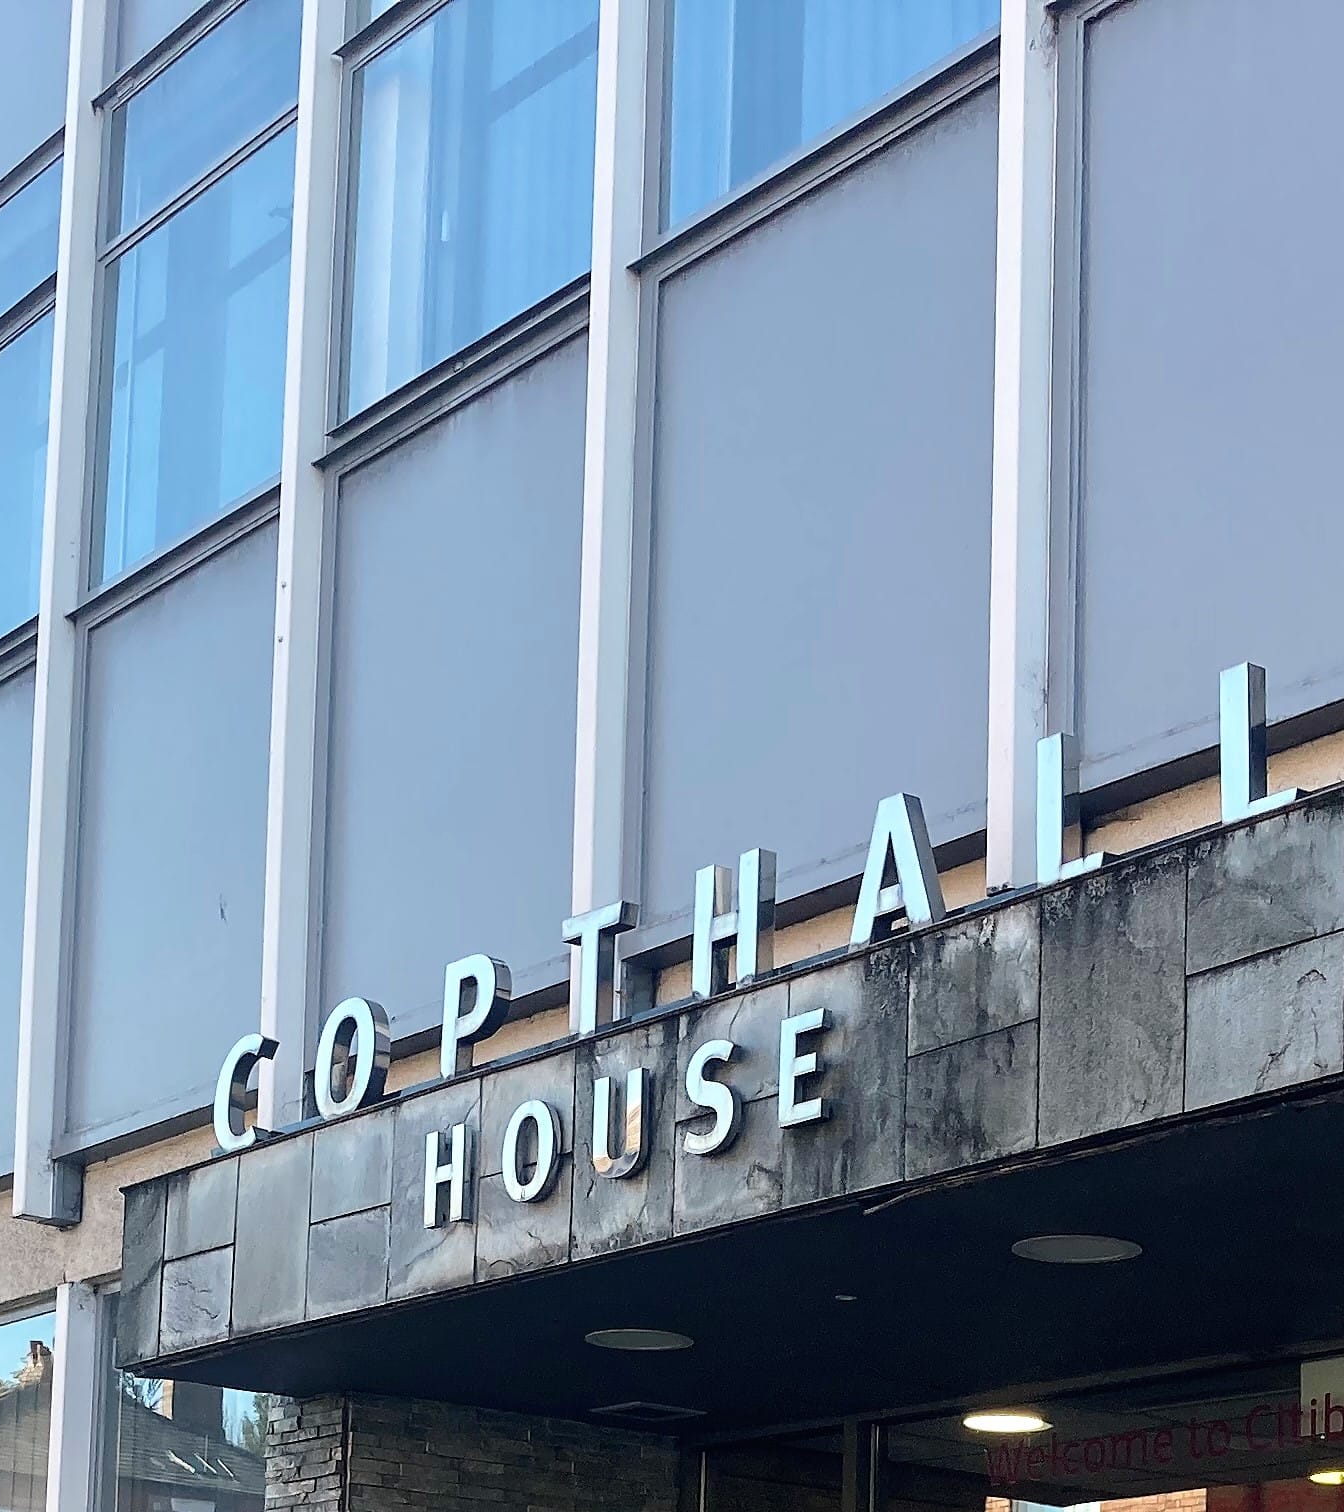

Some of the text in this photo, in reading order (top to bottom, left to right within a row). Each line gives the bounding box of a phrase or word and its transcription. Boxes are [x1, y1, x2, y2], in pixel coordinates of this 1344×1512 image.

[213, 661, 1301, 1153] COPTHALL
[423, 1007, 832, 1229] HOUSE
[985, 1426, 1174, 1488] Welcome
[1188, 1420, 1231, 1460] to
